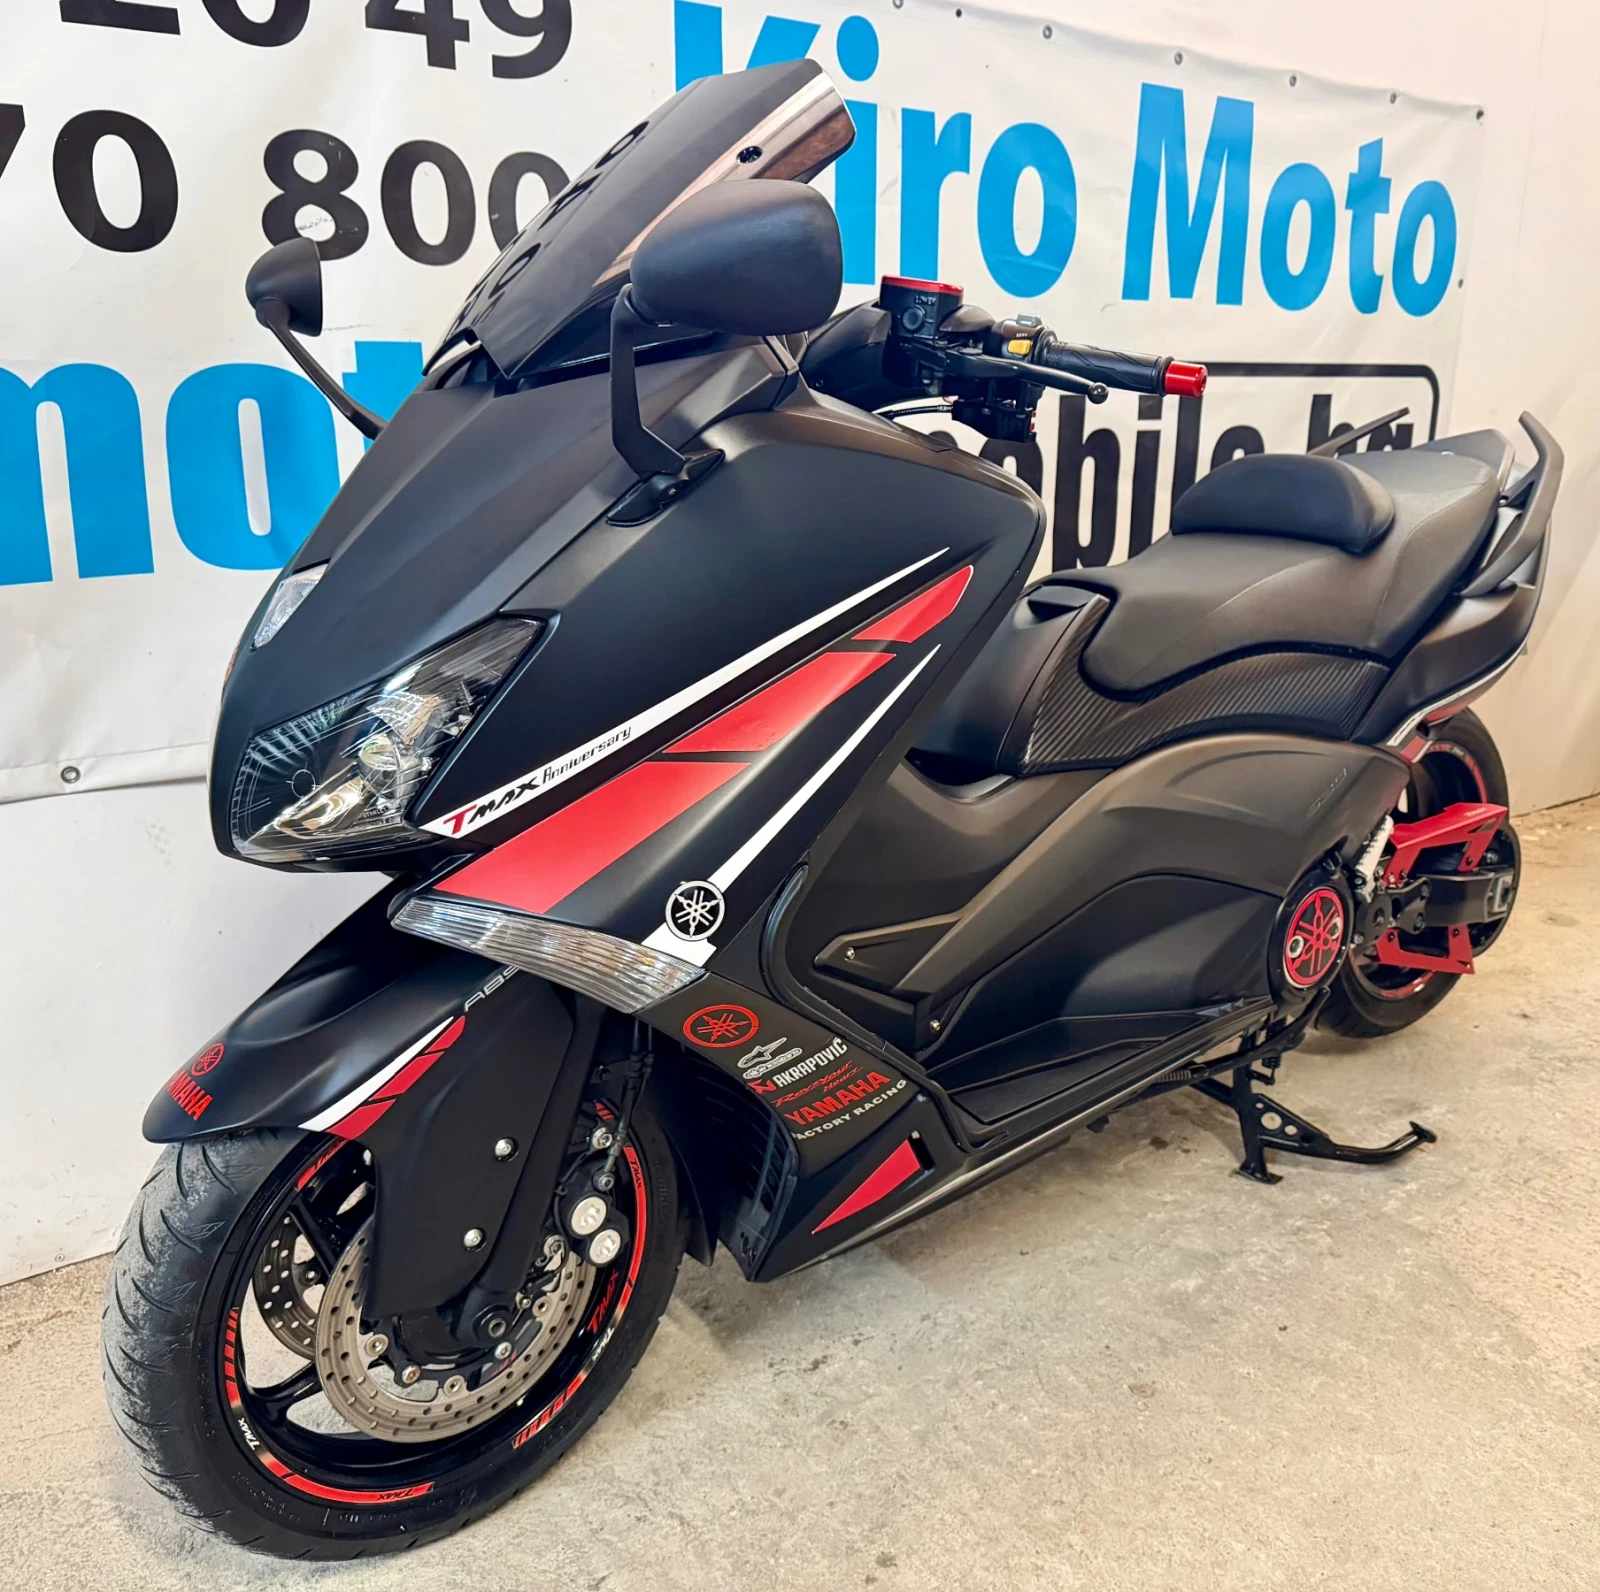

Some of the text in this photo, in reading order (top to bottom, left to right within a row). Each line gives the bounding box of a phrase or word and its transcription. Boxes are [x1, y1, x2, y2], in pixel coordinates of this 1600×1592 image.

[0, 103, 178, 253] 0
[1121, 82, 1457, 318] Moto
[542, 726, 632, 784] Anniversary
[784, 1070, 891, 1126] YAMAHA
[853, 1079, 908, 1116] RACING
